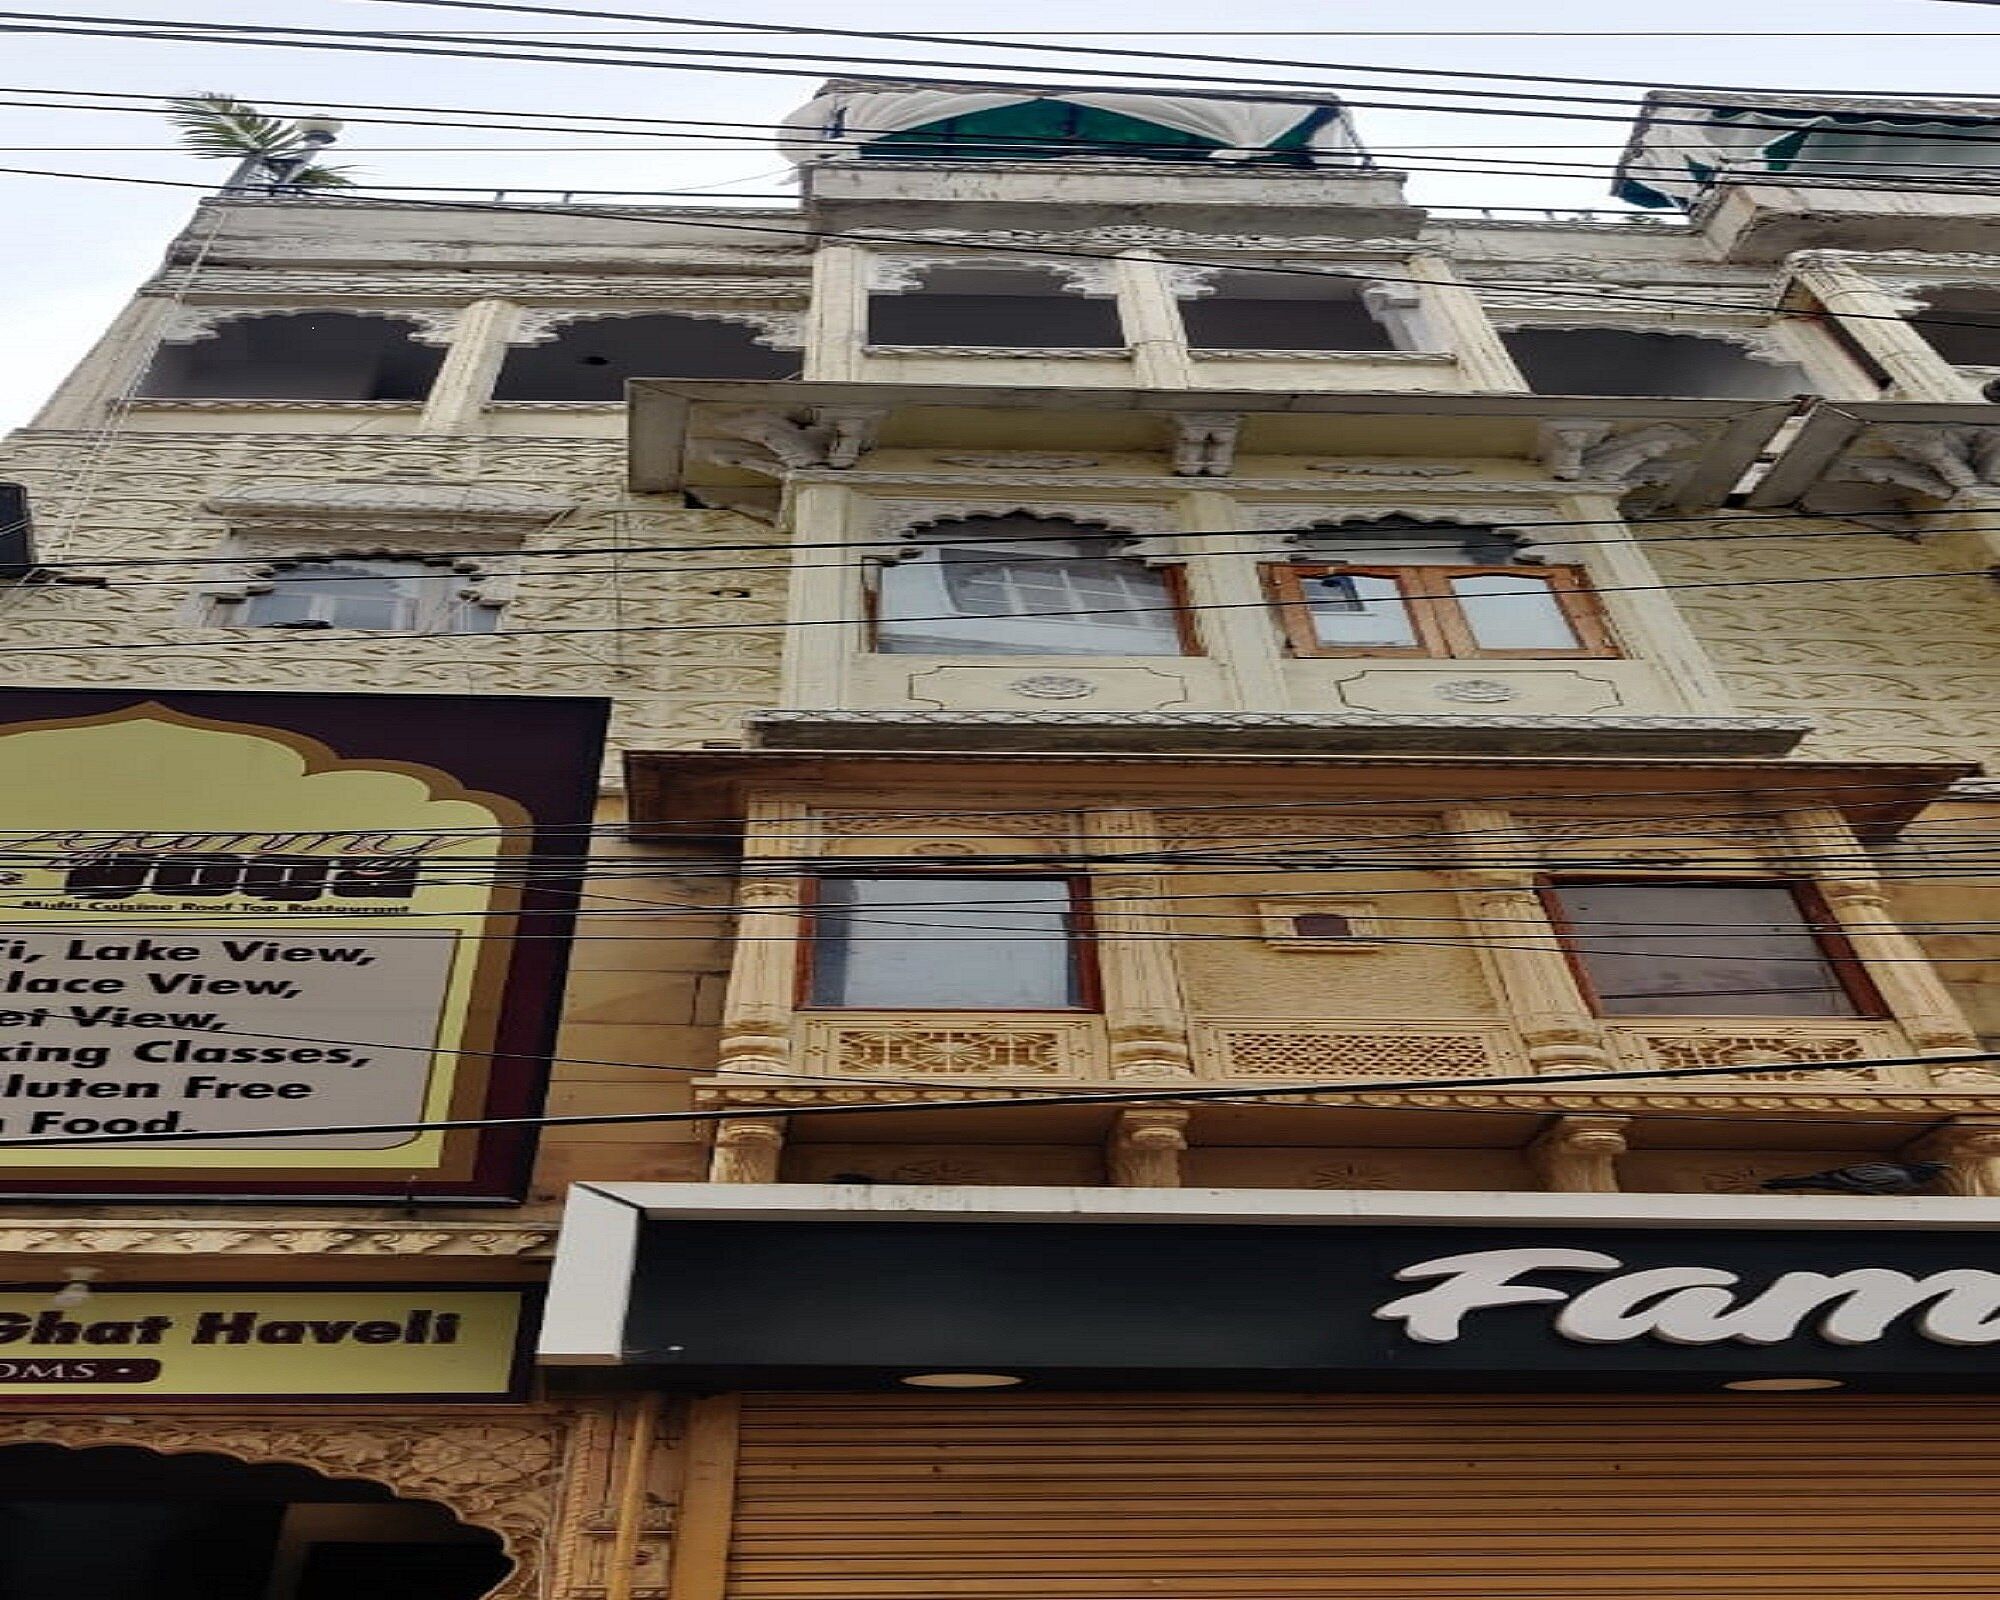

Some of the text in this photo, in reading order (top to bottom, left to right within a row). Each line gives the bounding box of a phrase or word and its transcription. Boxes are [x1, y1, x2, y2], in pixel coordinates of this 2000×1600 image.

[181, 903, 234, 912] Roof
[0, 939, 376, 966] i, Lake View,
[0, 971, 304, 999] lace View,
[70, 1006, 229, 1031] View,
[134, 1039, 373, 1068] Classes,
[184, 1076, 314, 1099] Free
[30, 1111, 199, 1134] Food.
[1372, 1247, 2000, 1344] Fam
[191, 1309, 462, 1345] Haveli
